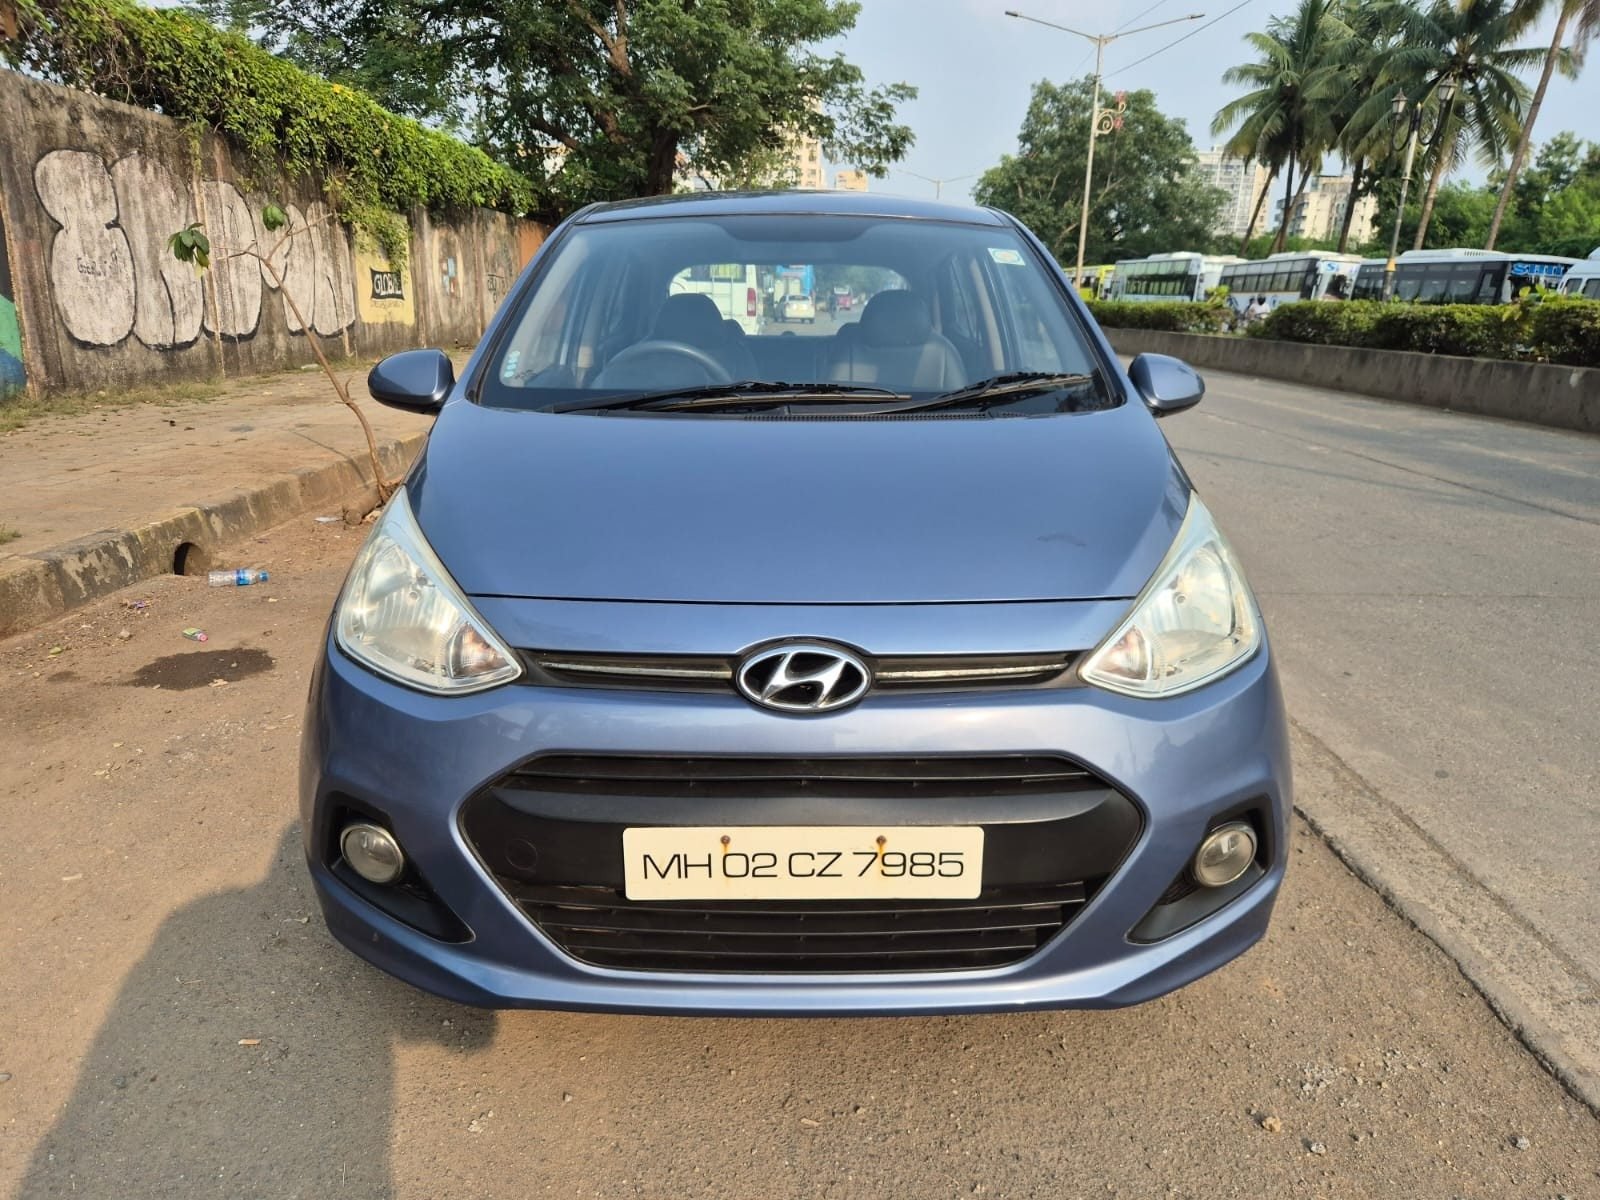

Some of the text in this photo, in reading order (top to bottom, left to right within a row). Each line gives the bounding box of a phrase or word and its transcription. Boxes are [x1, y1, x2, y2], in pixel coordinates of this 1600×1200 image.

[643, 852, 965, 880] MH 02 CZ 7985
